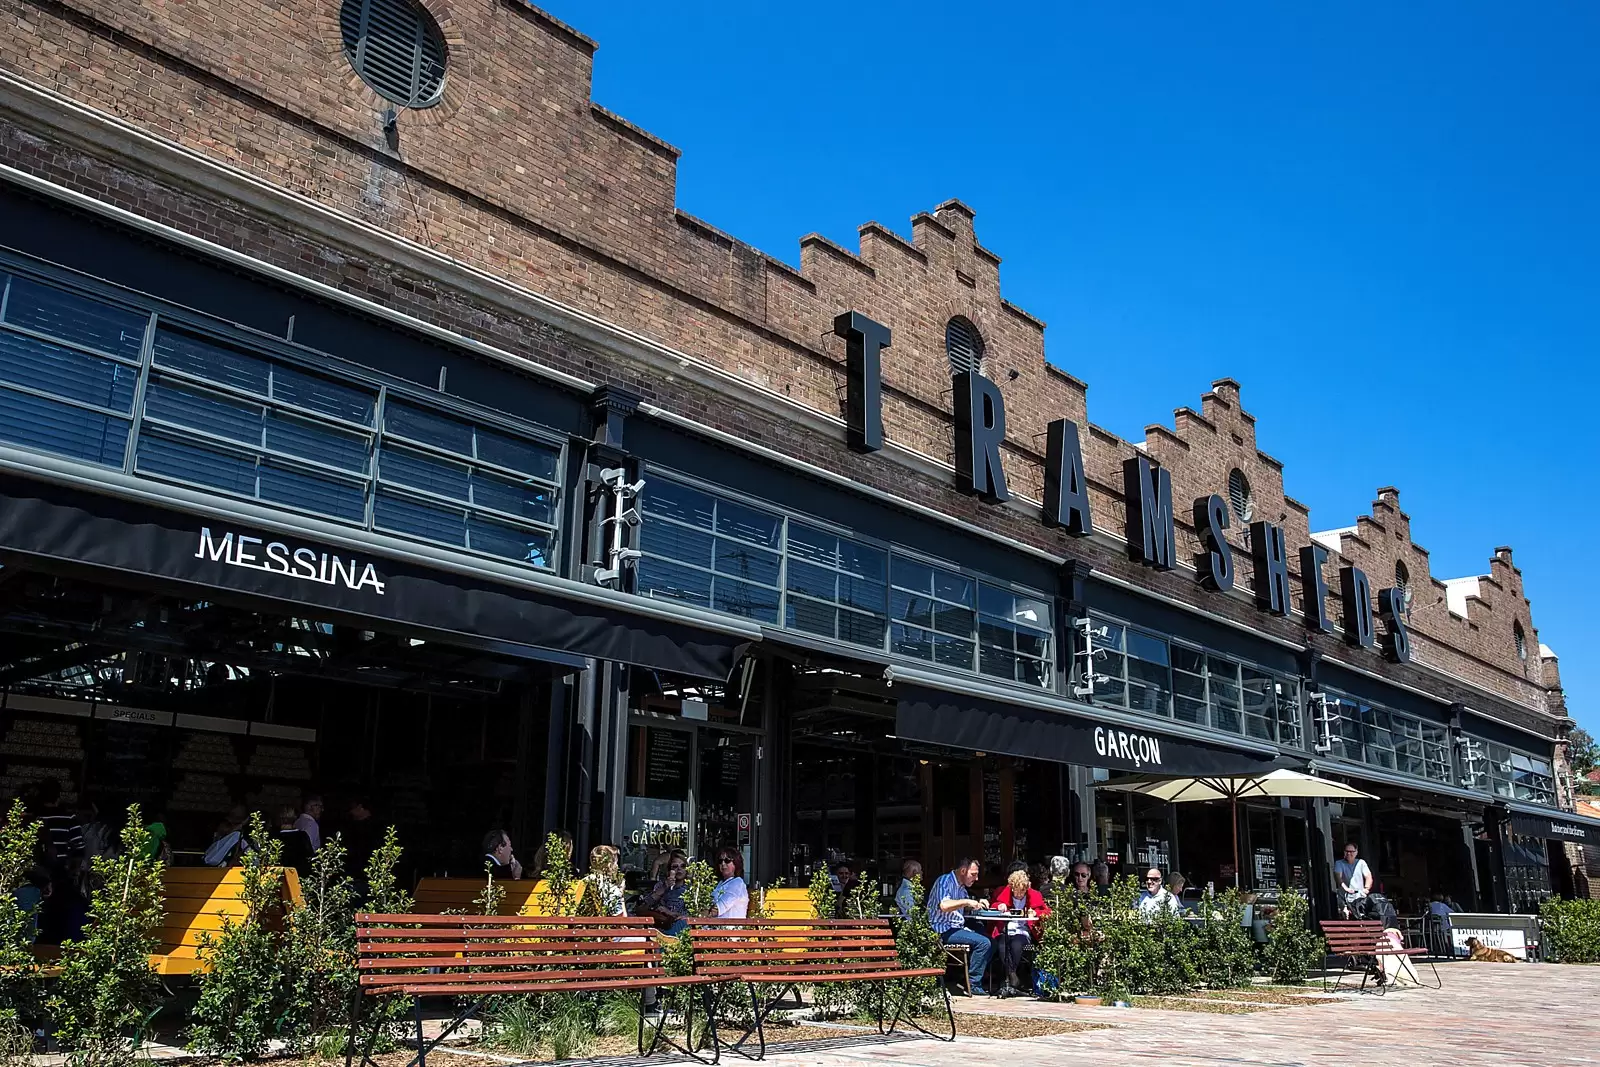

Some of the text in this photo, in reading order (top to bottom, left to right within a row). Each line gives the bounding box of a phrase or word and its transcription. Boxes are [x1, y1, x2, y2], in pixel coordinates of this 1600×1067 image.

[834, 309, 1411, 664] TRAMSHEDS
[194, 526, 385, 595] MESSINA
[113, 709, 156, 721] SPECIALS
[1094, 726, 1162, 768] GARÇON
